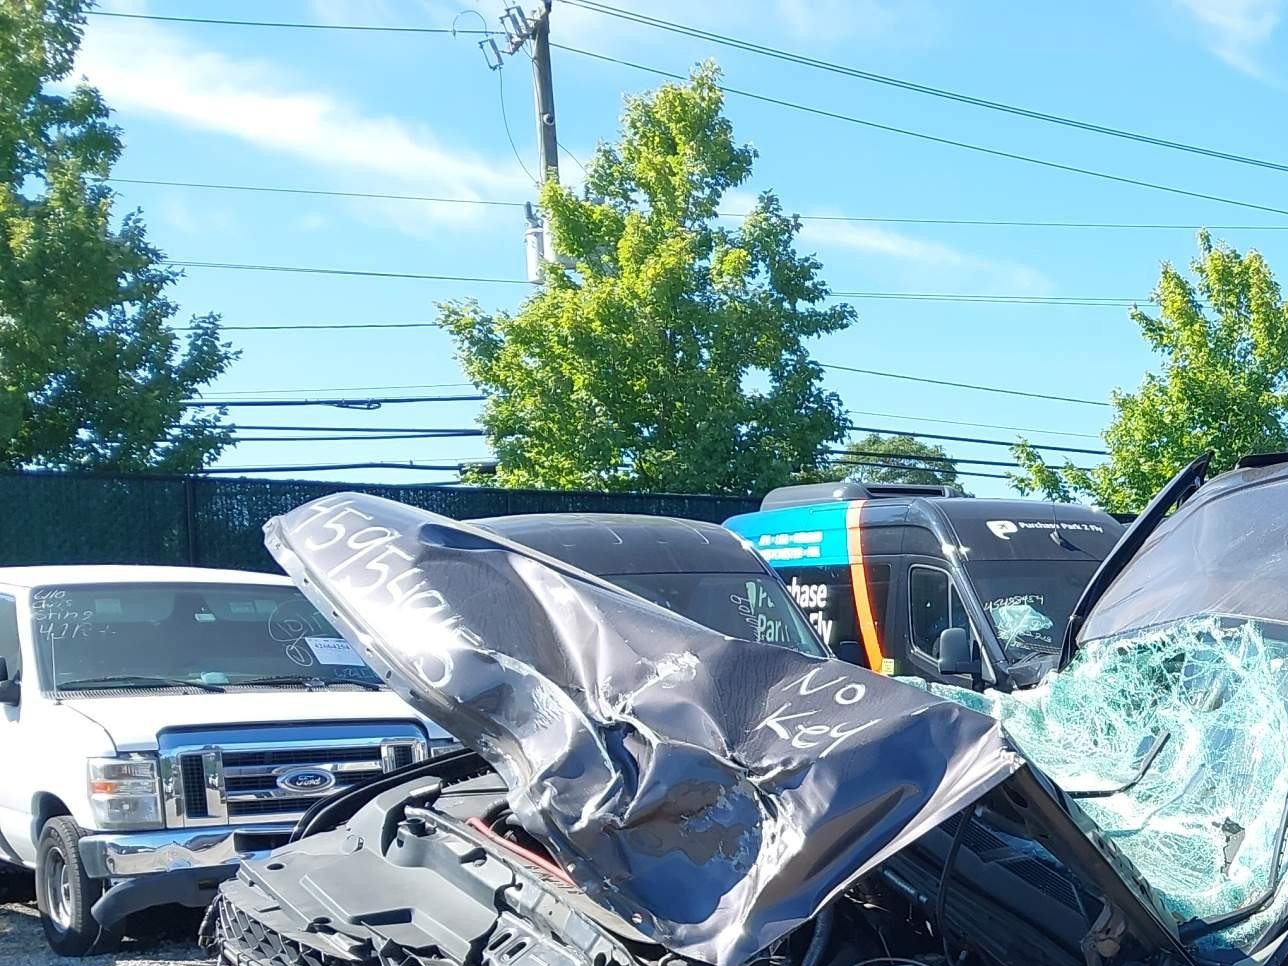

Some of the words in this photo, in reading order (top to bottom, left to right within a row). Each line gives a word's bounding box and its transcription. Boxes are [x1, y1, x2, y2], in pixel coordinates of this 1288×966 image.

[1060, 522, 1083, 531] Park
[1090, 524, 1104, 534] Fly
[781, 667, 866, 705] No
[752, 702, 882, 758] Key
